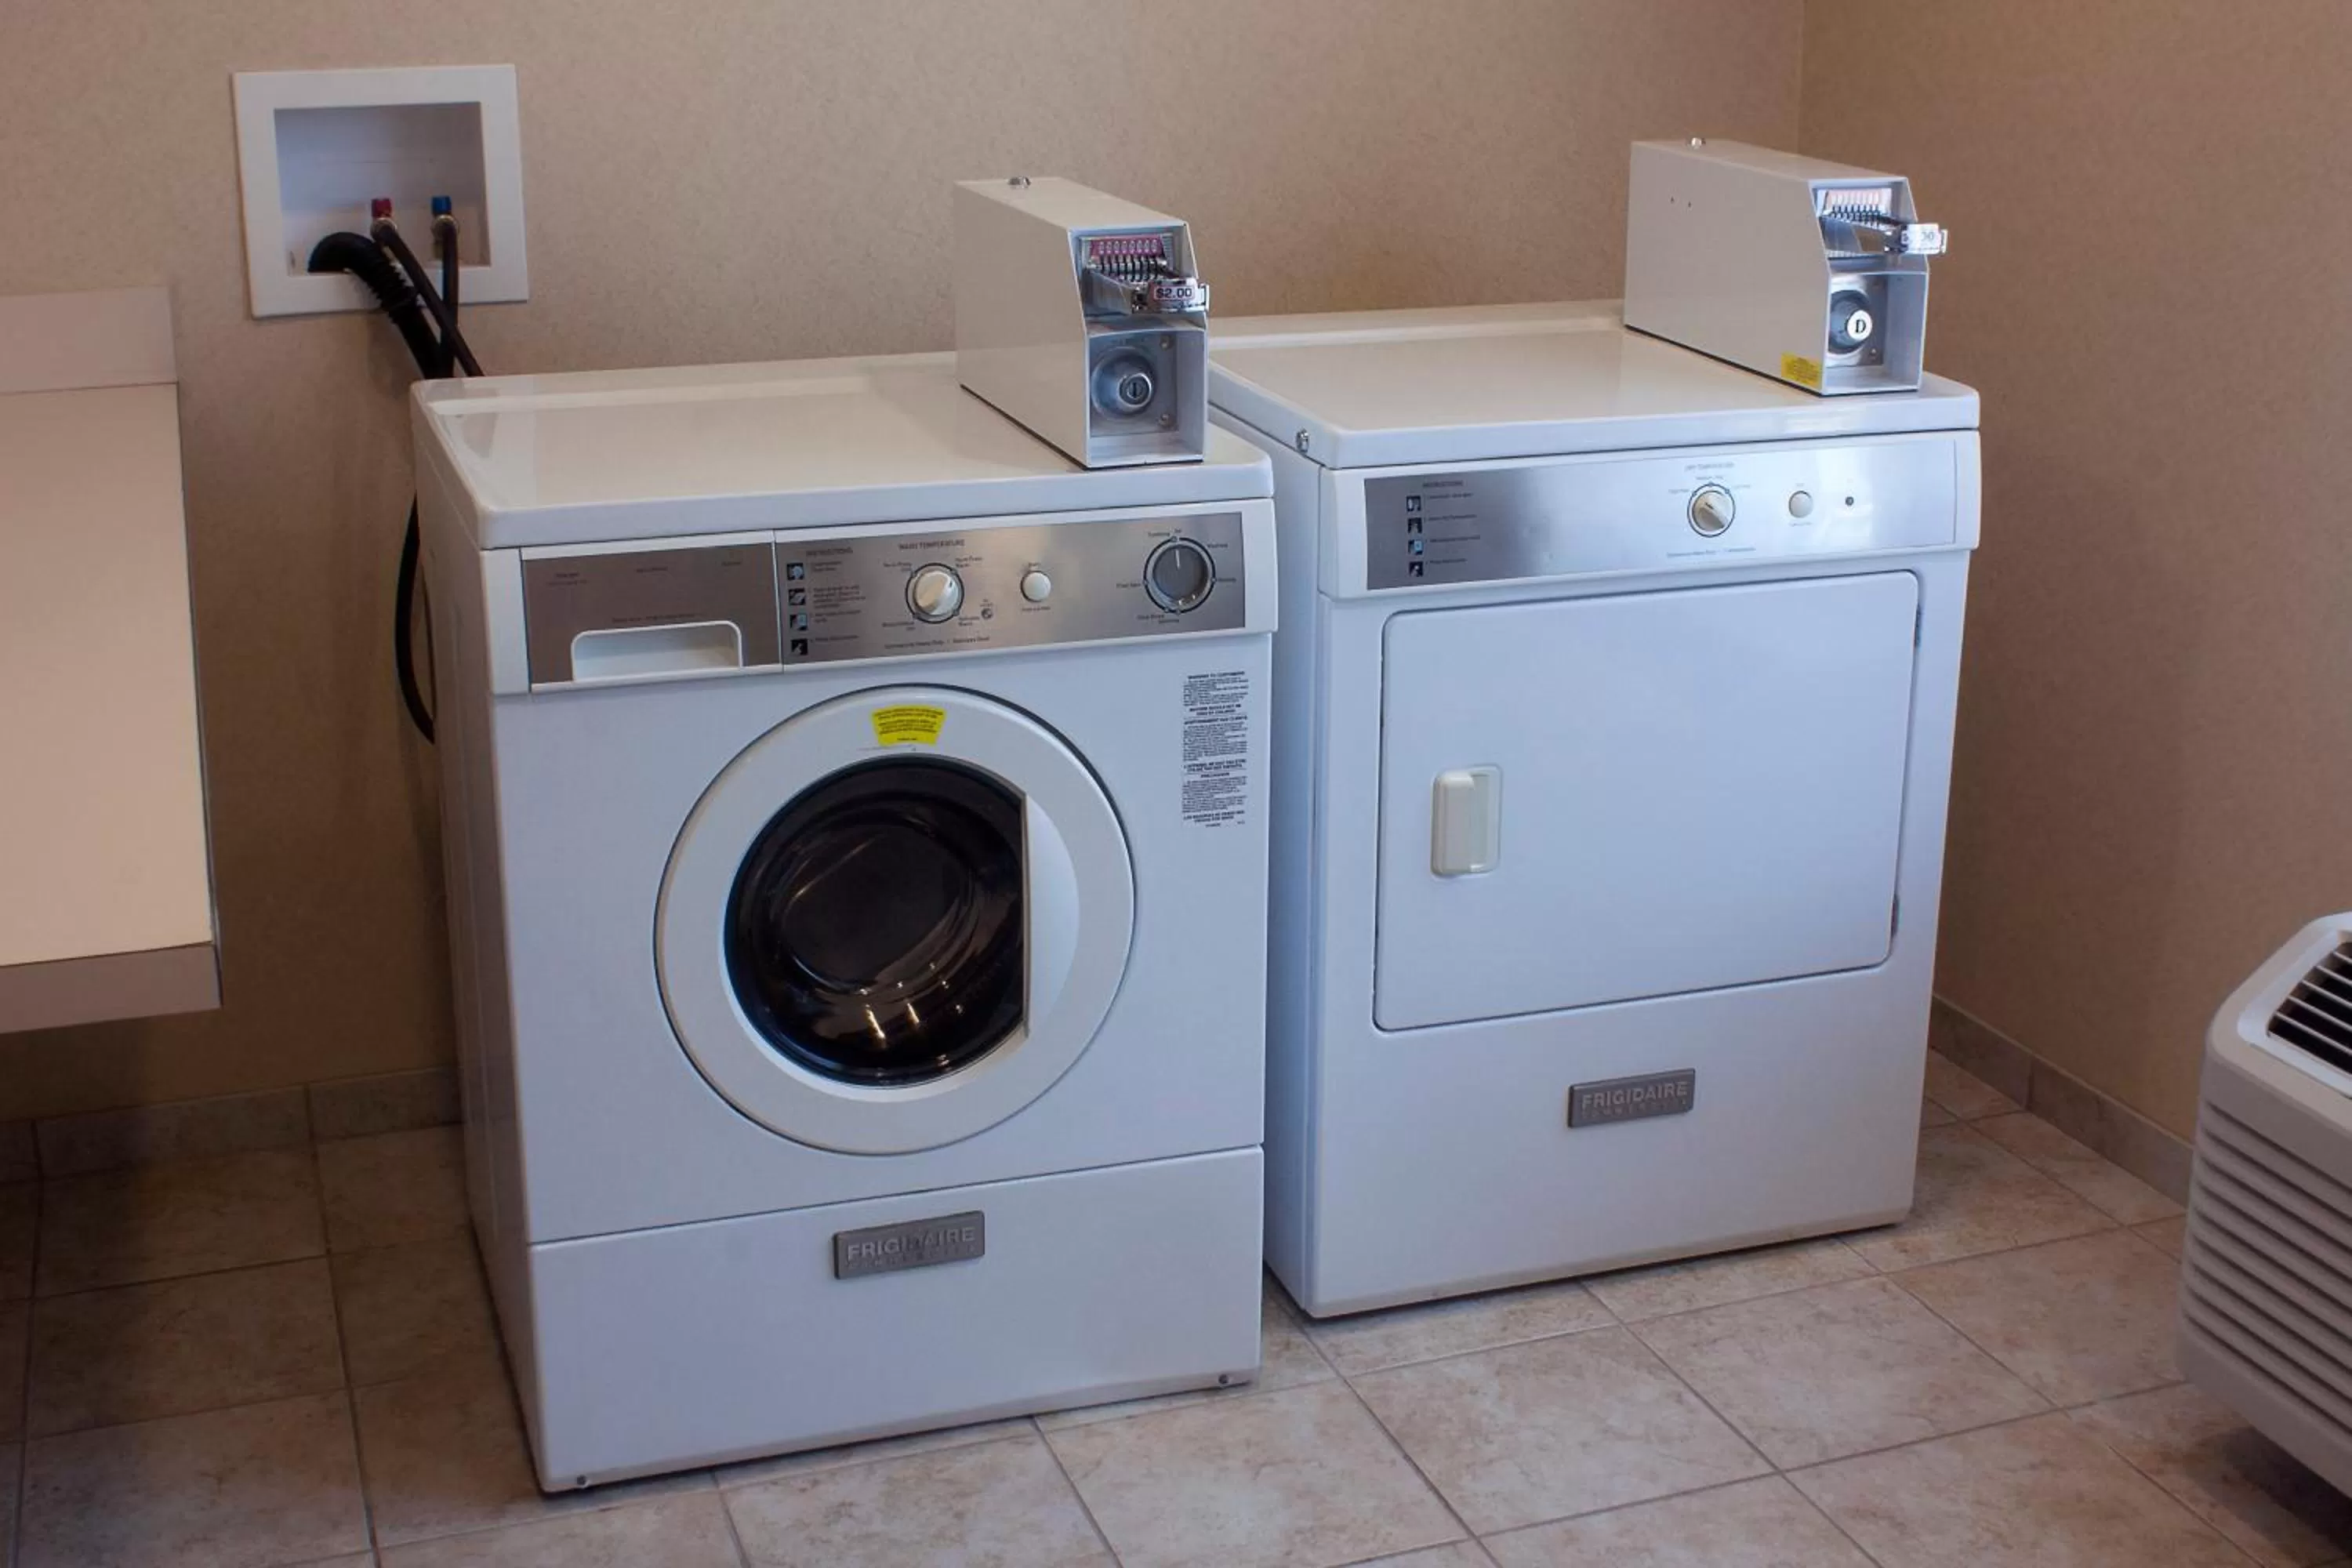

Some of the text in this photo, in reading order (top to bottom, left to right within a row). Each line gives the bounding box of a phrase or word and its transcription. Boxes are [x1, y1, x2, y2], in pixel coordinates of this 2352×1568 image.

[1156, 288, 1192, 299] $2.00
[1856, 319, 1867, 333] D
[1581, 1081, 1689, 1111] FRIGIDAIRE
